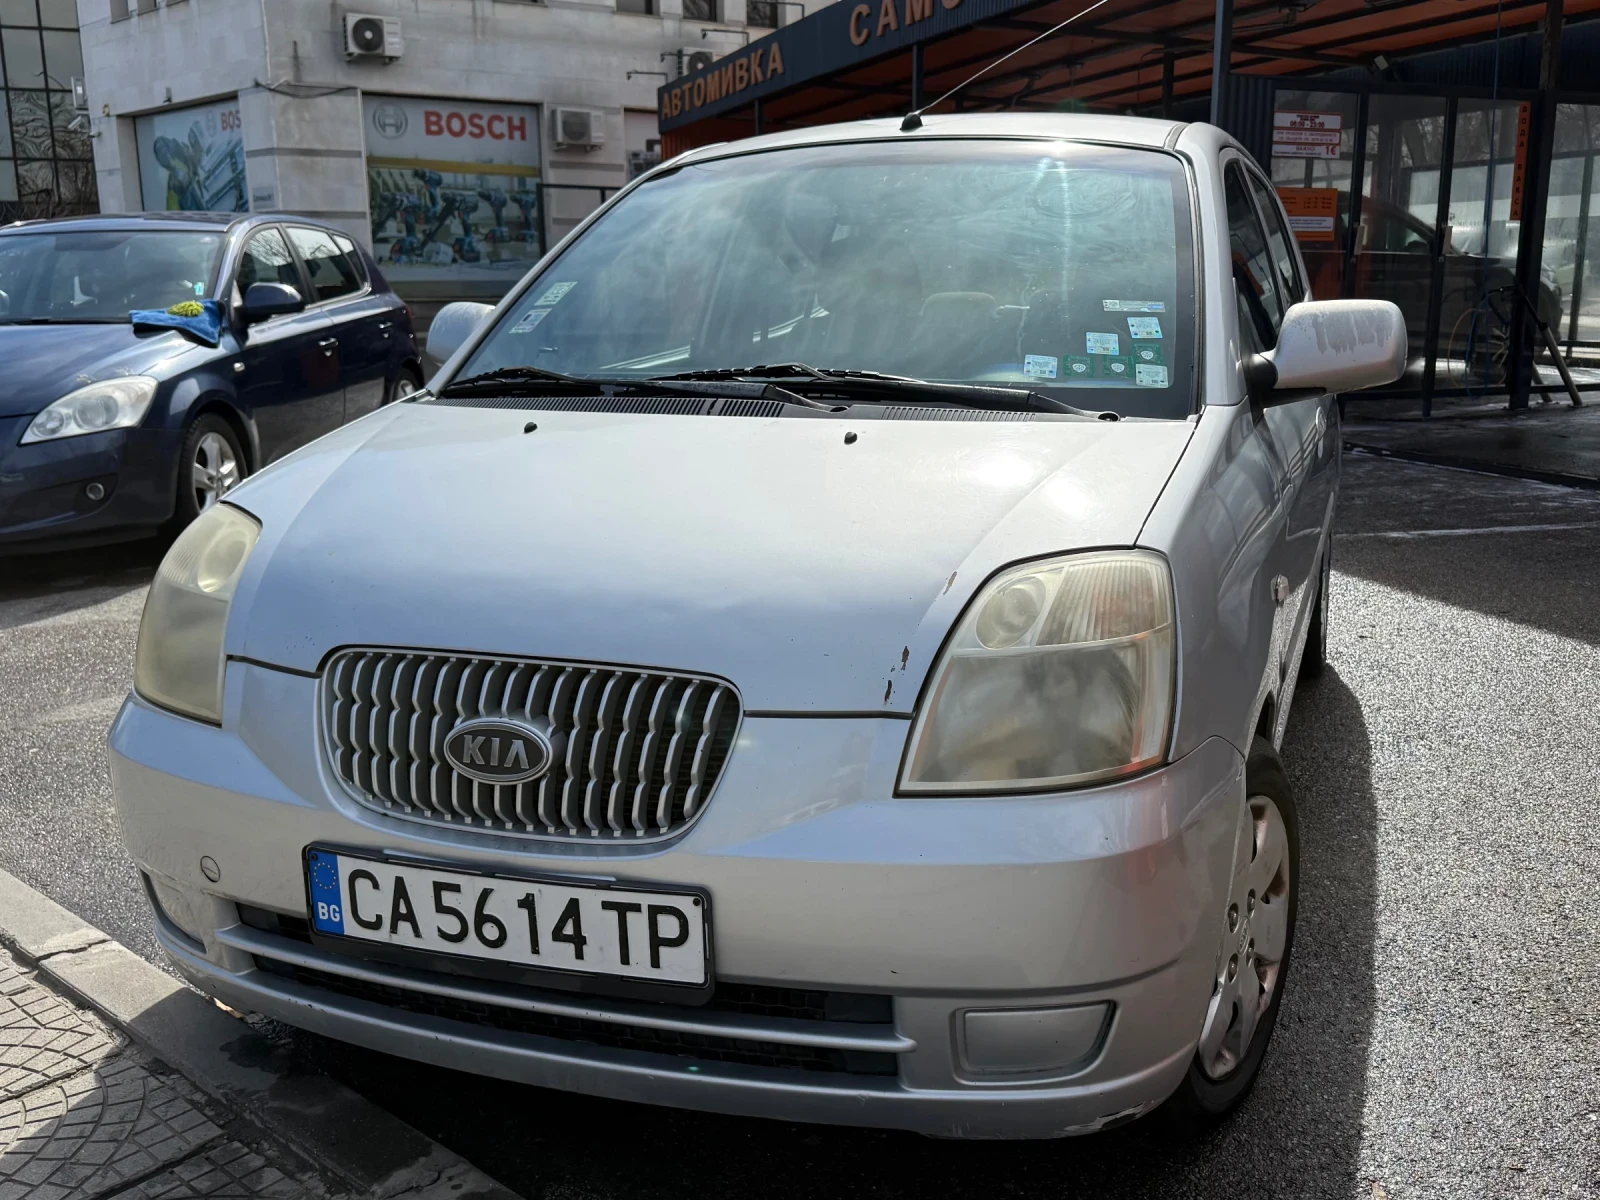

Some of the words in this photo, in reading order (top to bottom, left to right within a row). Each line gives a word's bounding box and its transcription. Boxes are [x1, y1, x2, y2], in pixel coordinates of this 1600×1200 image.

[850, 0, 961, 46] САМ
[662, 42, 784, 120] АВТОМИВКА
[424, 110, 527, 141] BOSCH
[1519, 105, 1528, 148] ВОДА
[1513, 163, 1523, 216] ВАКСА
[463, 735, 530, 769] KIA
[318, 901, 341, 923] BG
